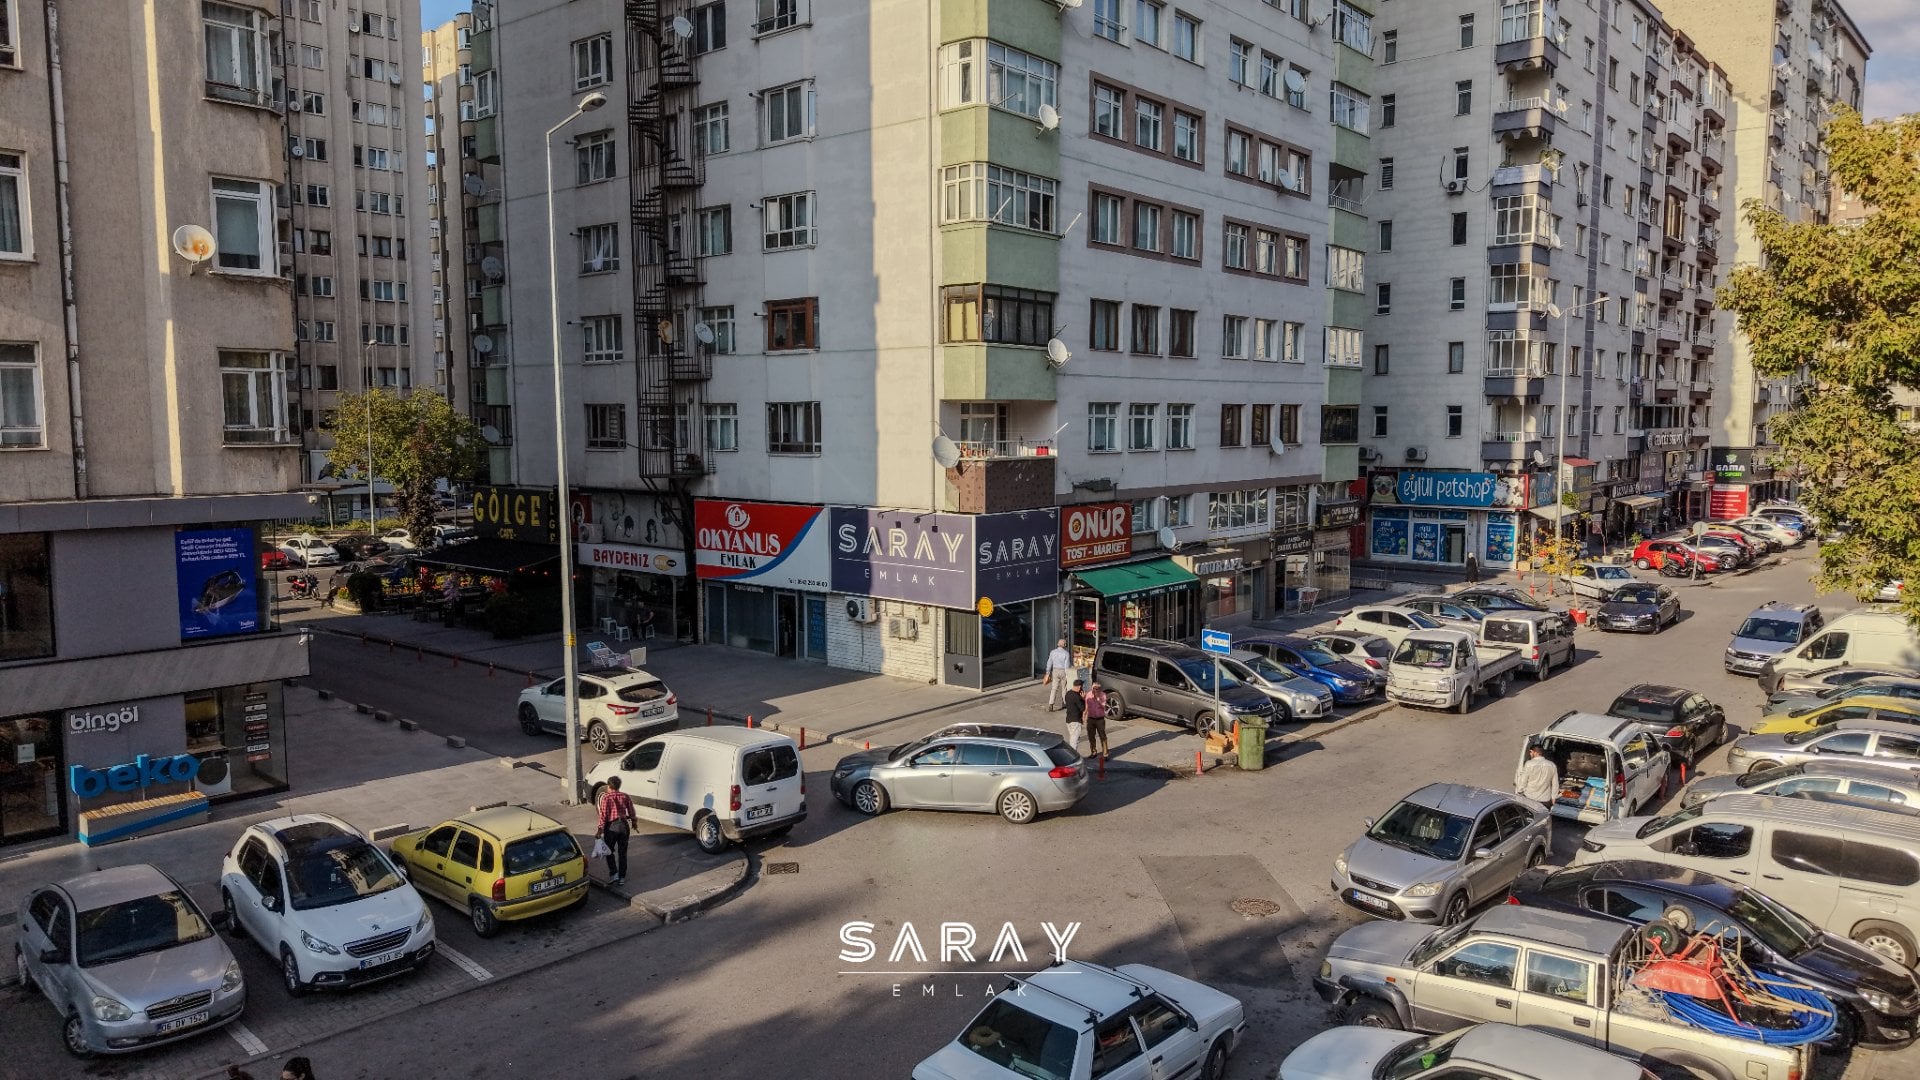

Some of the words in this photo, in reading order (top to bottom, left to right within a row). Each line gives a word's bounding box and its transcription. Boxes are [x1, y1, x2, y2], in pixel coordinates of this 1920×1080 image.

[1404, 476, 1433, 502] eylül
[1436, 477, 1490, 502] petshop
[473, 488, 541, 527] GÖLGE
[1068, 506, 1126, 541] ONUR
[698, 527, 781, 556] OKYANUS
[838, 523, 965, 563] SARAY
[979, 533, 1056, 565] SARAY
[1066, 546, 1088, 560] TOST
[1093, 541, 1126, 556] MARKET
[720, 553, 757, 569] EMLAK
[996, 566, 1040, 581] EMLAK
[864, 568, 935, 586] EMLAK
[70, 705, 139, 732] bingöl
[70, 753, 200, 799] beko
